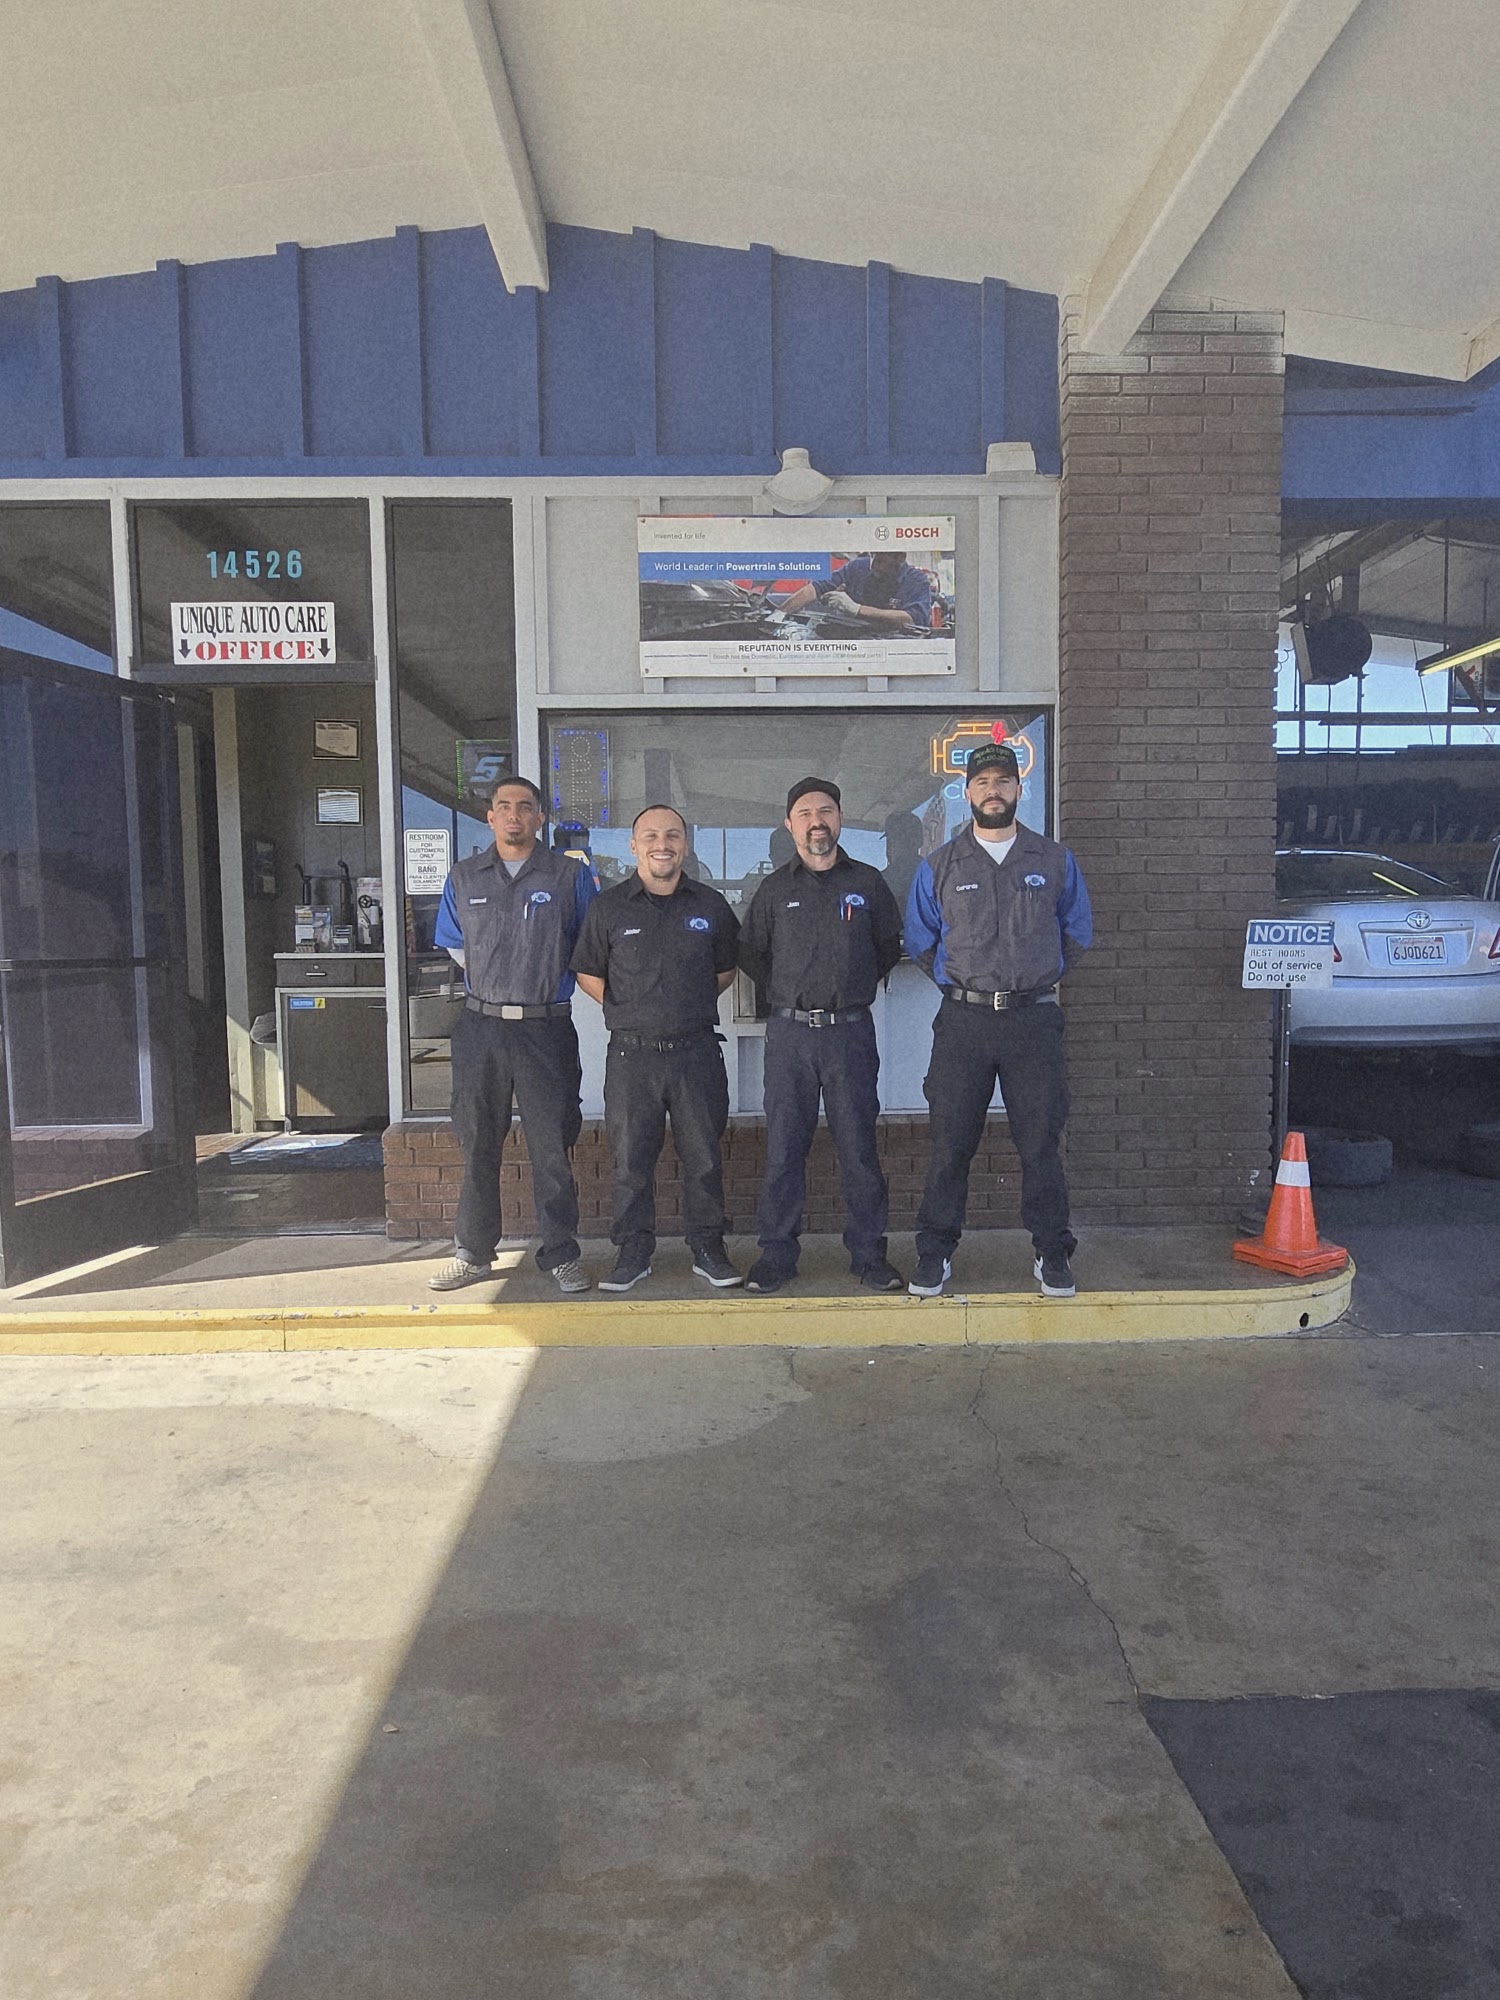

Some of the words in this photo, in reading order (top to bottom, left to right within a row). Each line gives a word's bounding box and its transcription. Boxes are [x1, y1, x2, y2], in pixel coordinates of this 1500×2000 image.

[653, 532, 683, 540] Invented
[684, 532, 693, 540] for
[694, 532, 706, 540] life
[895, 527, 939, 539] BOSCH
[206, 550, 303, 579] 14526
[654, 562, 681, 571] World
[683, 562, 714, 571] Leader
[716, 562, 725, 571] in
[726, 562, 776, 571] Powertrain
[778, 562, 821, 571] Solutions
[179, 606, 235, 639] UNIQUE
[240, 606, 281, 633] AUTO
[284, 605, 329, 633] CARE
[195, 640, 315, 661] OFFICE
[738, 644, 791, 652] REPUTATION
[793, 644, 802, 652] IS
[803, 643, 858, 652] EVERYTHING
[409, 833, 444, 841] RESTROOM
[1253, 925, 1332, 943] NOTICE
[1250, 949, 1273, 957] REST
[1278, 949, 1306, 958] ROOMS
[1248, 960, 1268, 970] Out
[1271, 960, 1284, 970] of
[1286, 960, 1323, 970] service
[1247, 971, 1263, 981] Do
[1266, 972, 1285, 982] not
[1288, 974, 1307, 982] use
